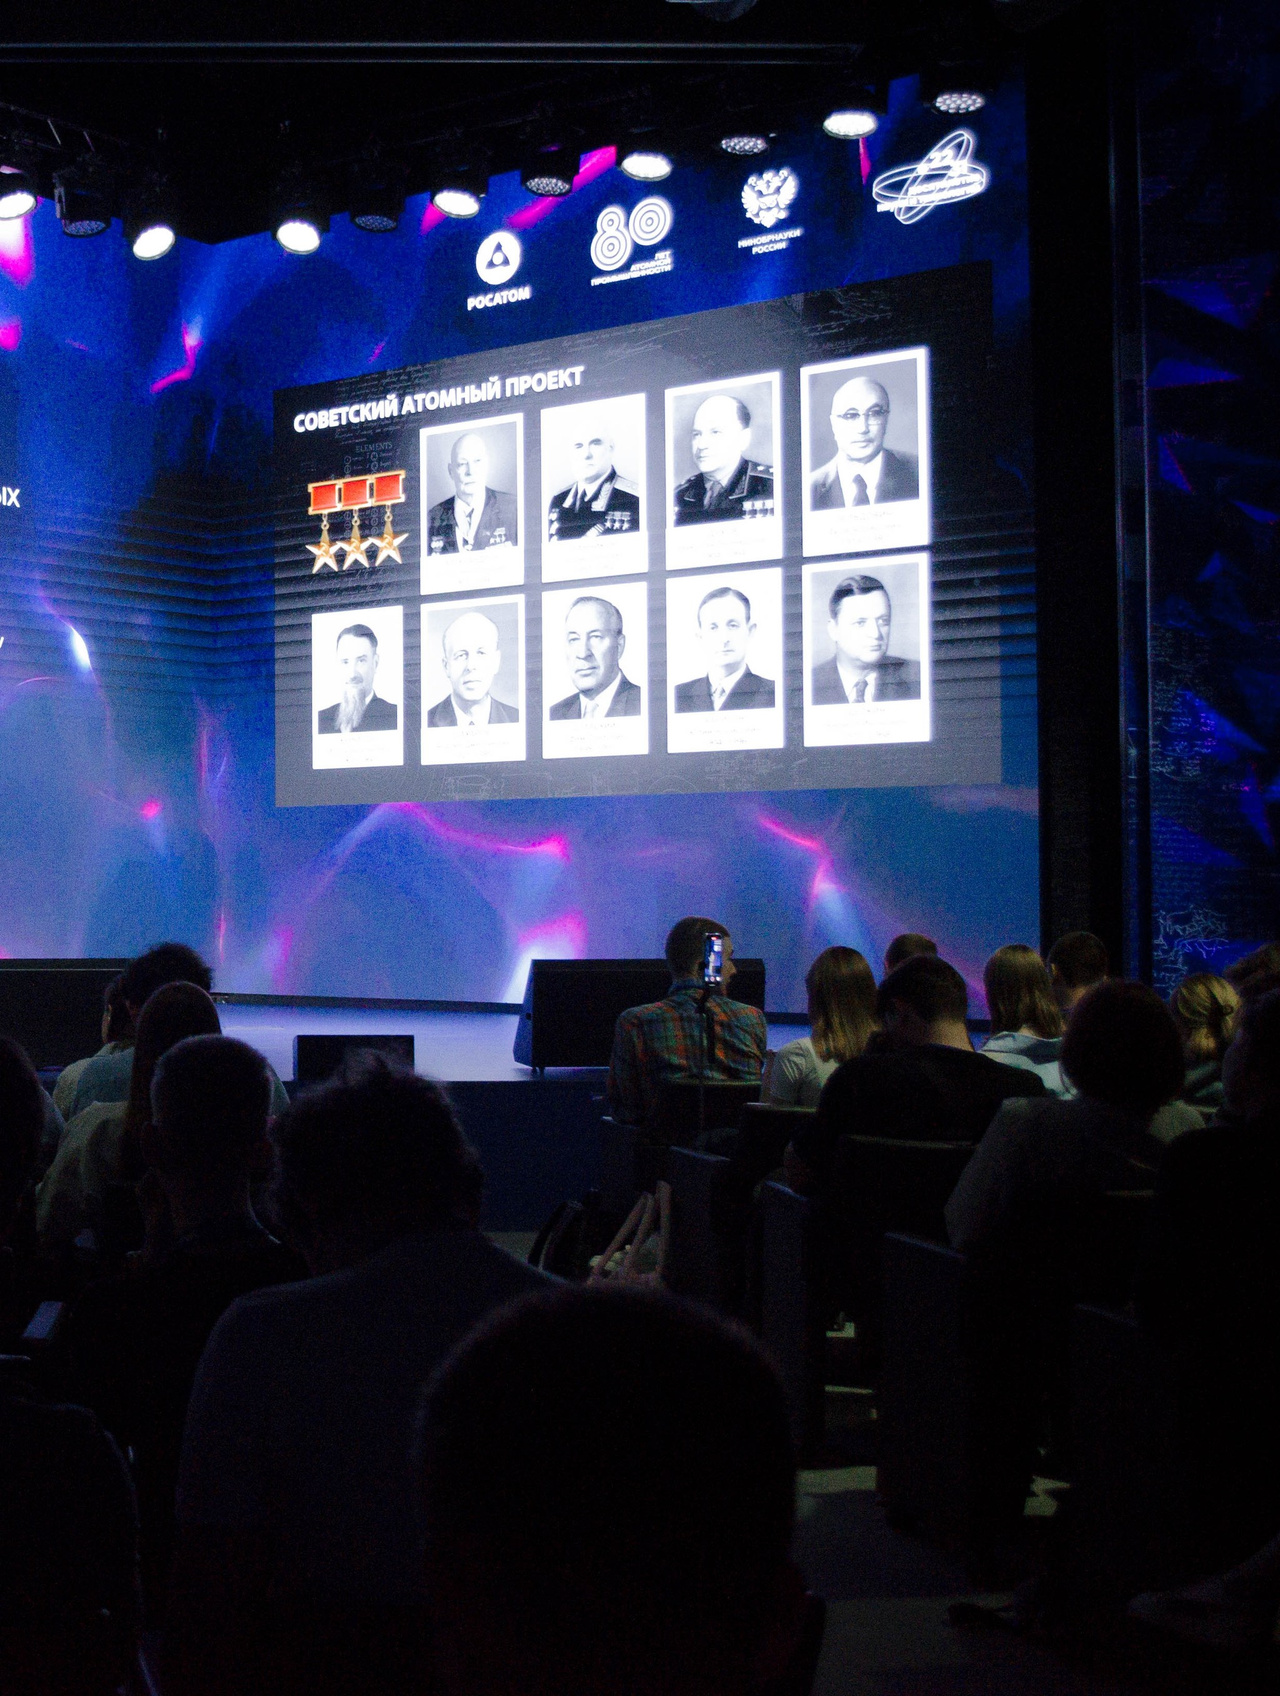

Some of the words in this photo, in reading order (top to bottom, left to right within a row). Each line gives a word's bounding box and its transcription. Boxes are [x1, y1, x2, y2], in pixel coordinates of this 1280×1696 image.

[737, 228, 801, 249] МИНОБРНАУКИ
[751, 241, 787, 255] РОССИИ
[466, 286, 531, 311] РОСАТОМ
[293, 394, 399, 433] СОВЕТСКИЙ
[401, 375, 502, 416] АТОМНЫЙ
[505, 365, 585, 398] ПРОЕКТ
